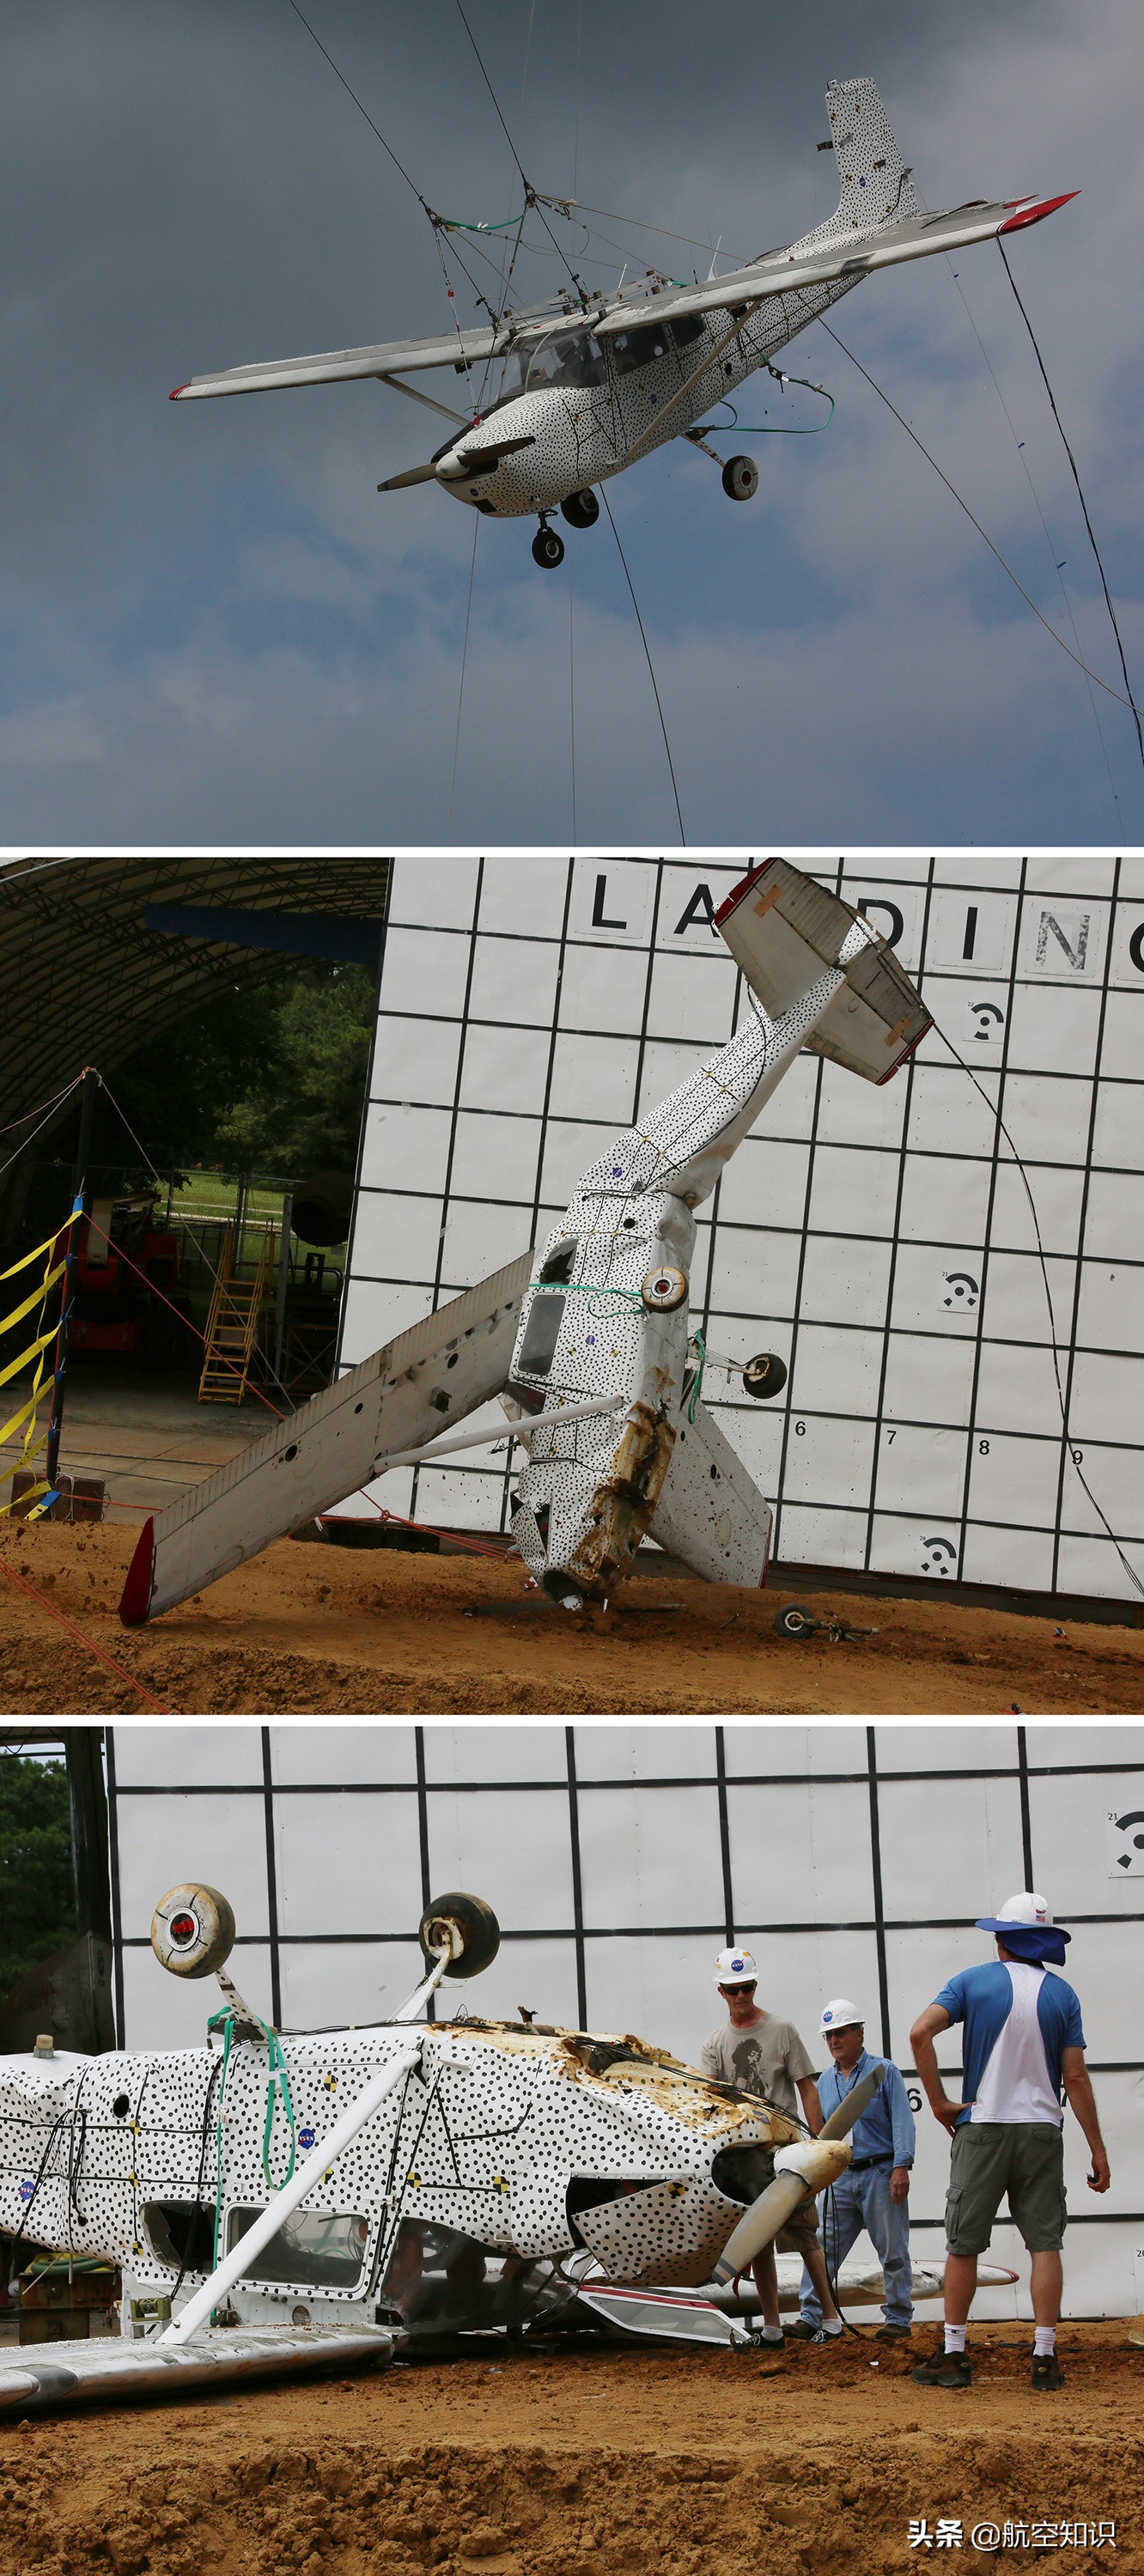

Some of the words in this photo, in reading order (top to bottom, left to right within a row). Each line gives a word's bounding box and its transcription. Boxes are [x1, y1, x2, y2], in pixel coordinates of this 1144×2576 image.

[592, 874, 1144, 976] LADIN
[794, 1421, 806, 1437] 6
[886, 1430, 898, 1445] 7
[978, 1440, 990, 1455] 8
[1071, 1449, 1084, 1466] 9
[907, 2087, 922, 2112] 6
